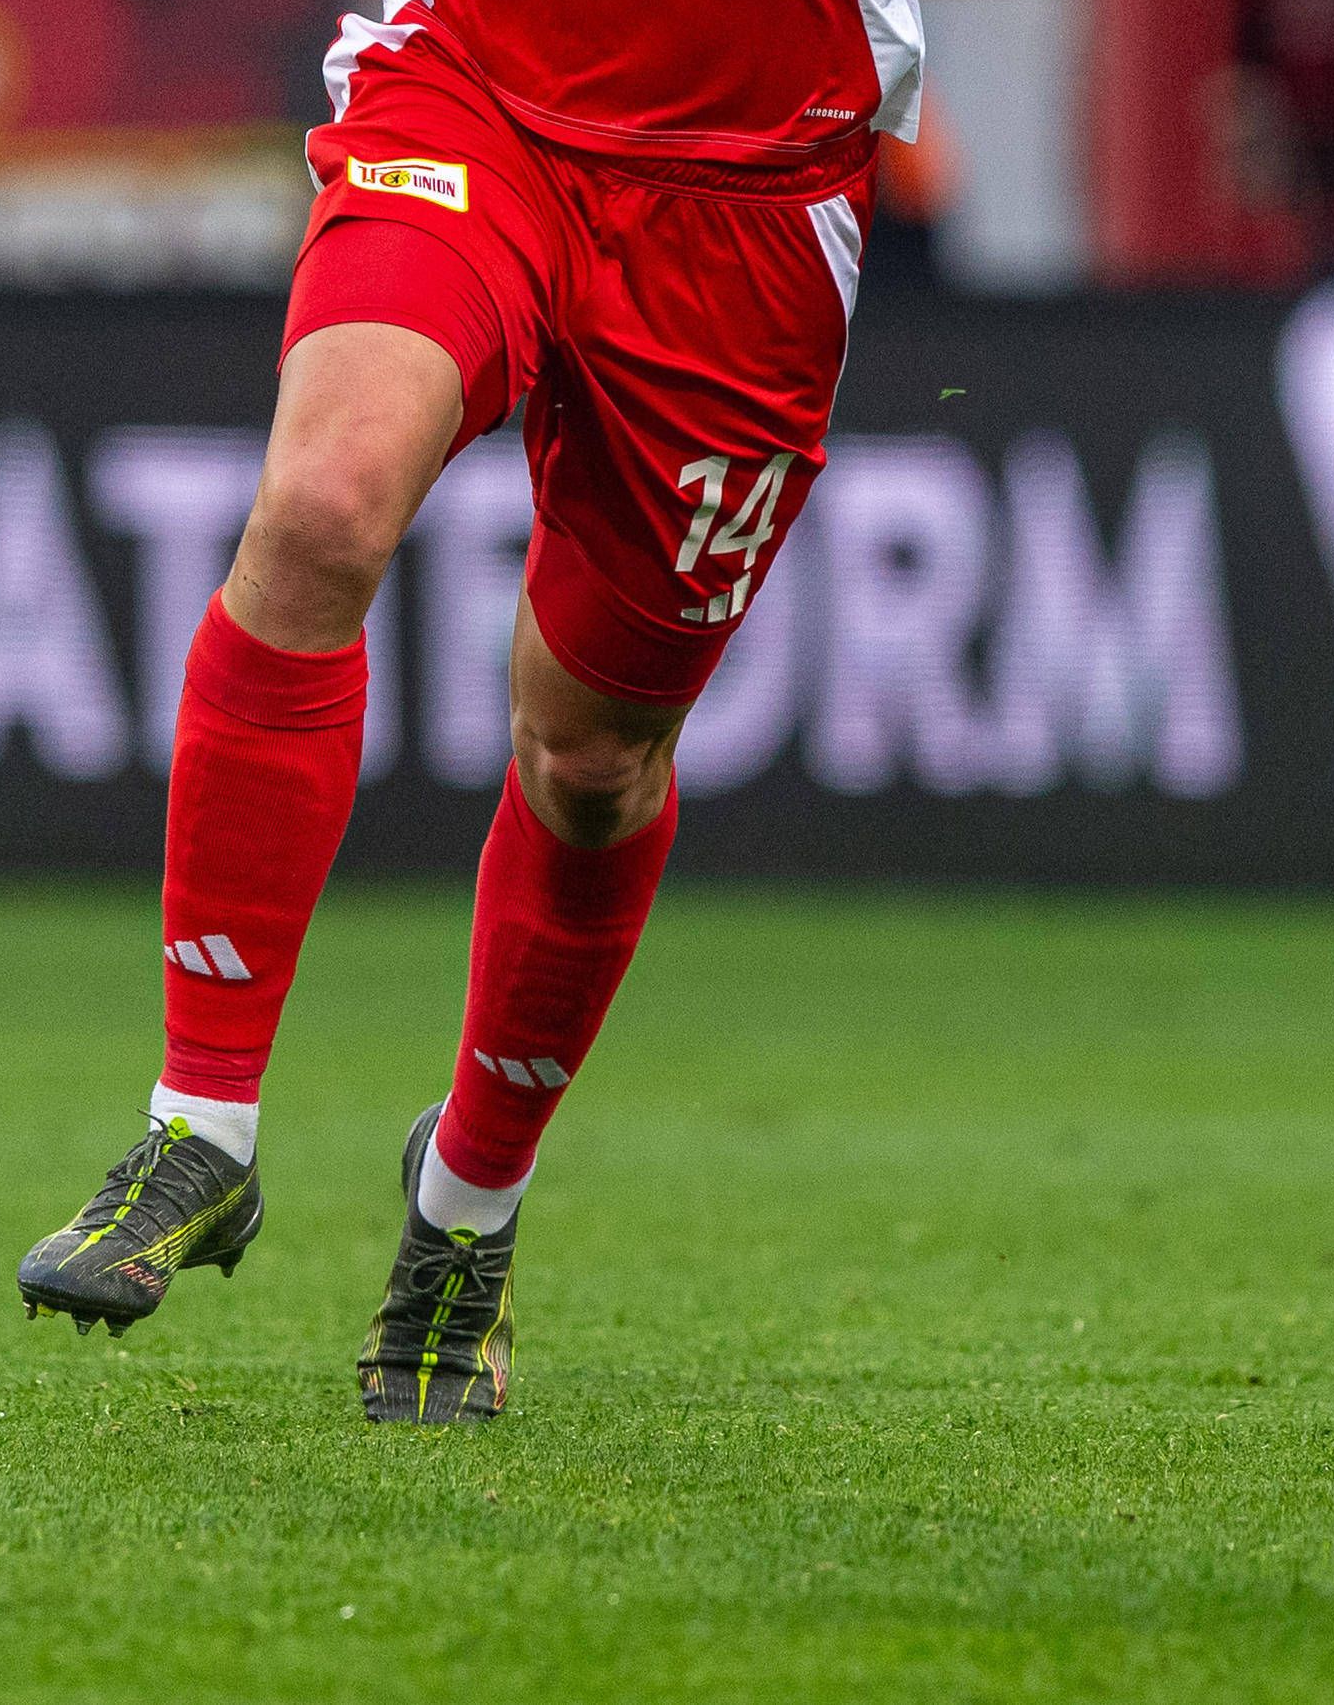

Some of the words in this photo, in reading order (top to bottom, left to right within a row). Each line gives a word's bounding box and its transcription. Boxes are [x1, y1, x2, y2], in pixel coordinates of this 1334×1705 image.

[803, 107, 857, 121] AEROREADY
[412, 174, 456, 198] UNION
[674, 452, 797, 573] 14
